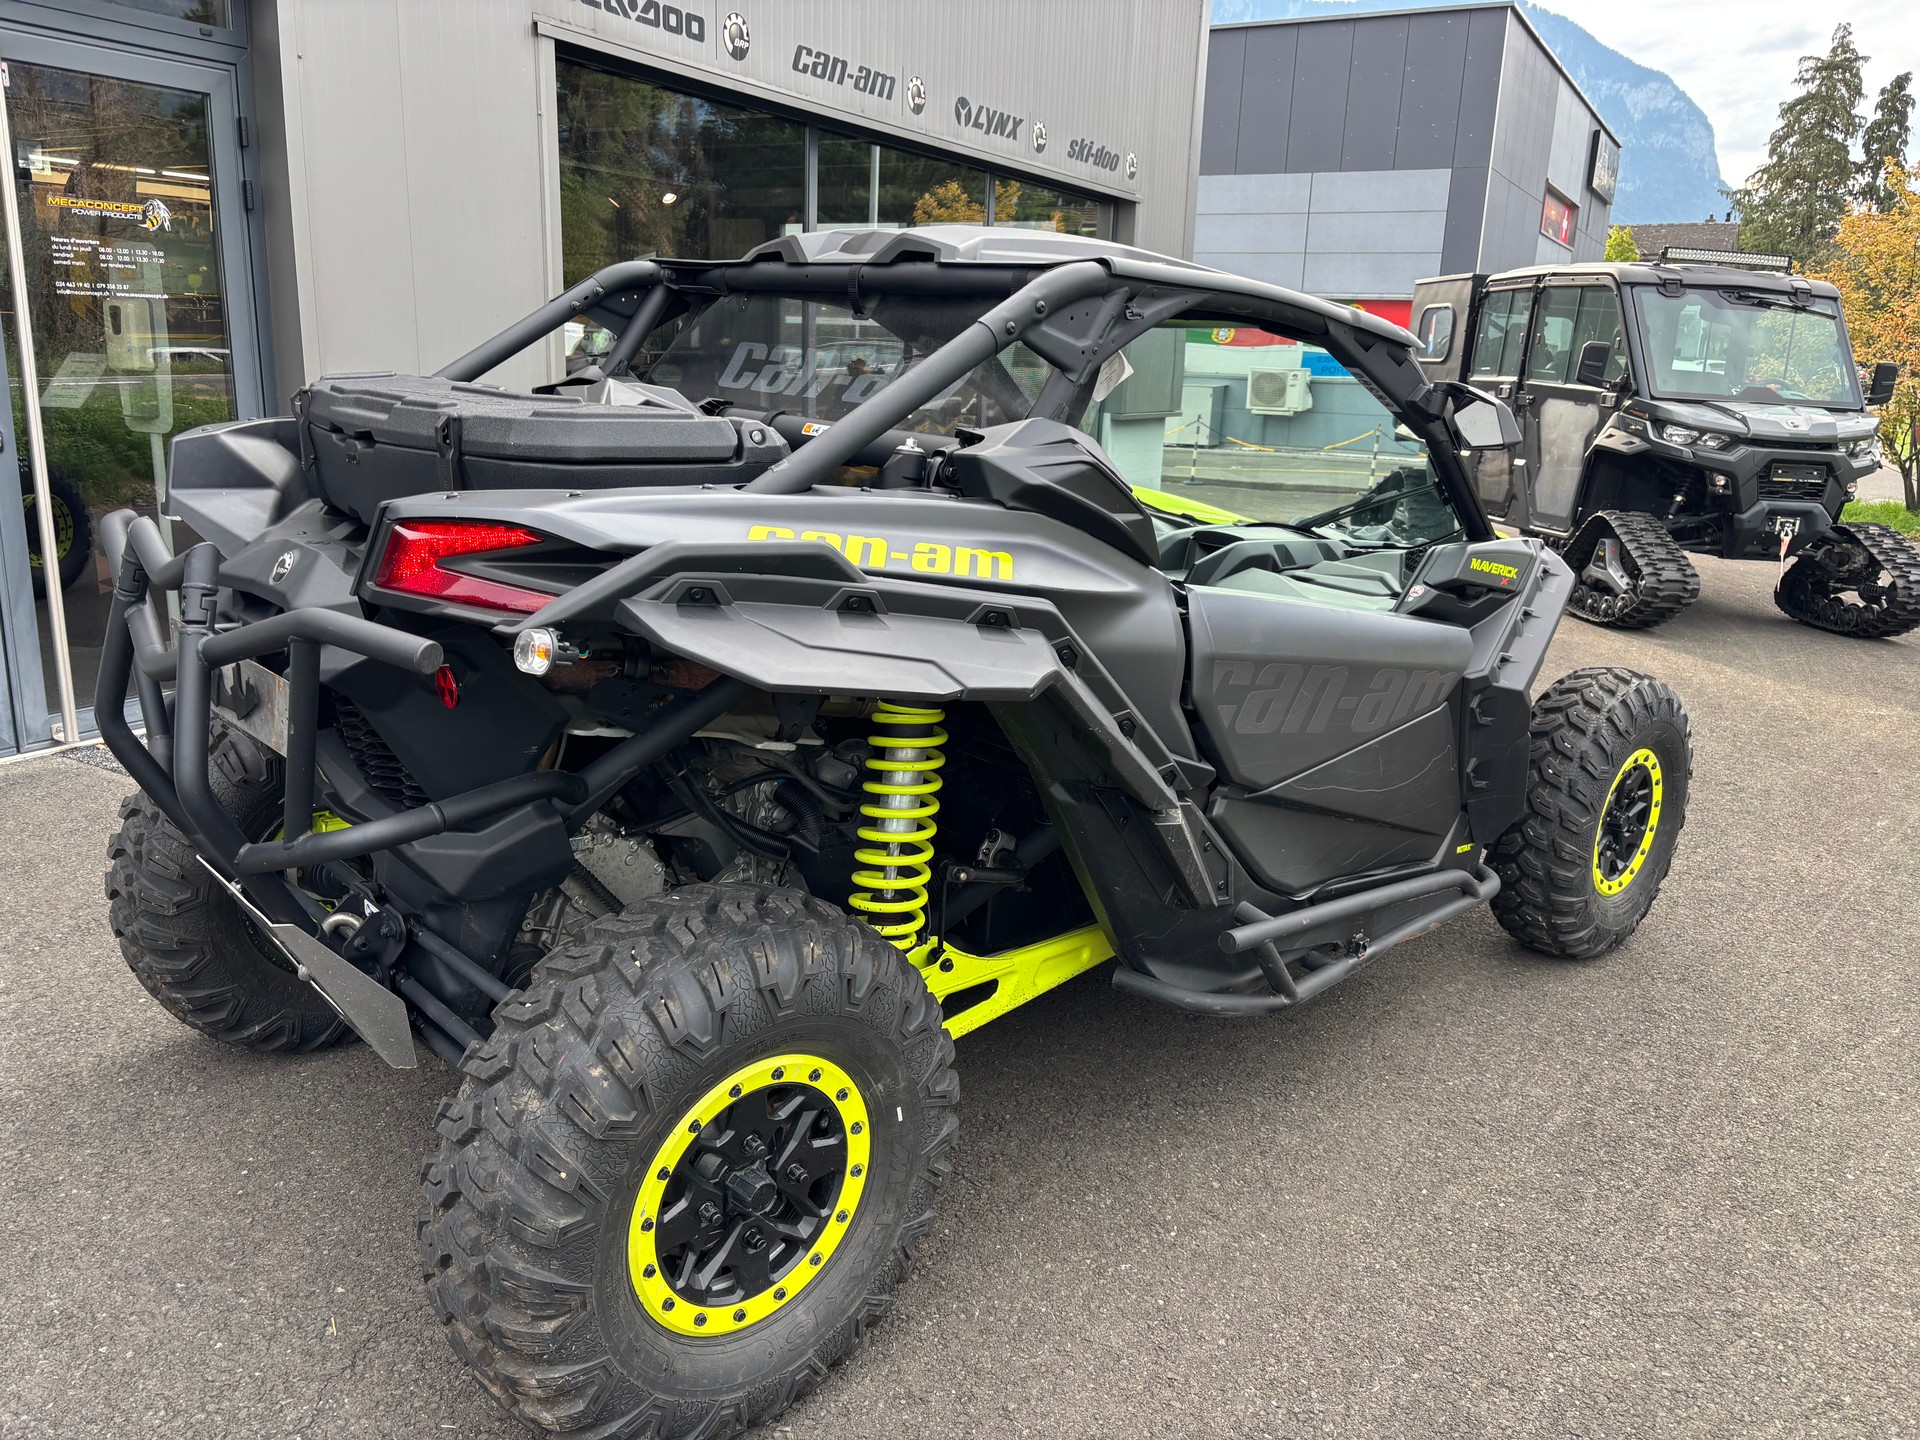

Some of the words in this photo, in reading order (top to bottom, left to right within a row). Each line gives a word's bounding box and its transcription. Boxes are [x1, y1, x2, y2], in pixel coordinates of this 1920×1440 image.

[792, 44, 896, 101] can-am
[971, 104, 1025, 141] LYNX
[1066, 137, 1120, 172] ski-doo
[48, 195, 145, 213] MECACONCEPT
[71, 208, 101, 217] POWER
[102, 211, 143, 220] PRODUCTS
[1469, 557, 1519, 579] MAVERICK
